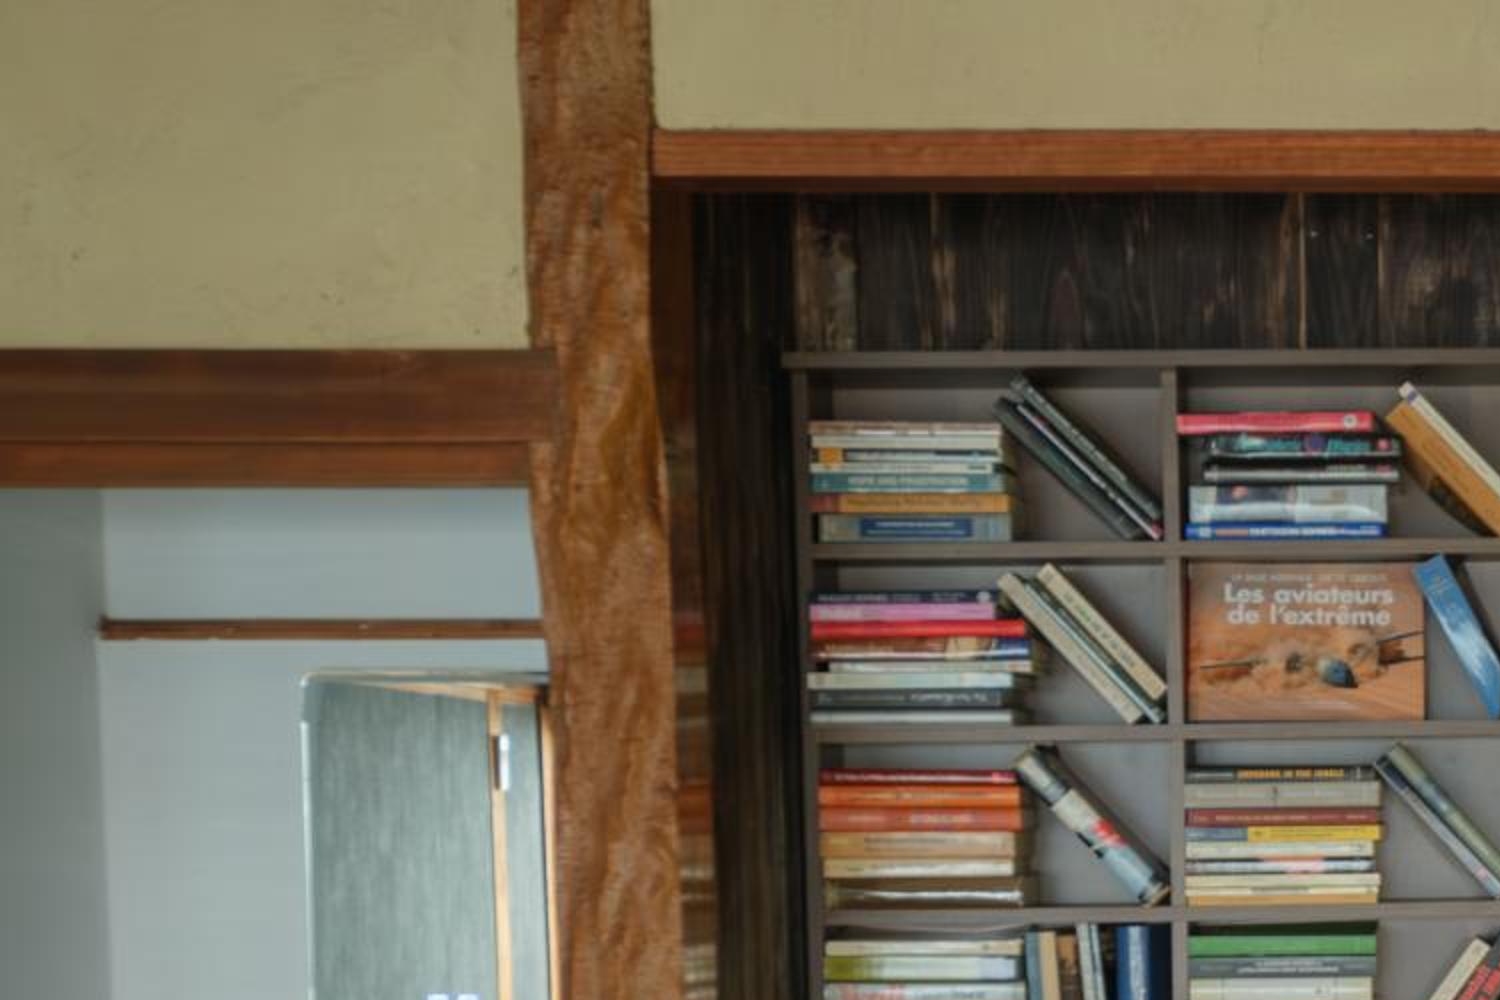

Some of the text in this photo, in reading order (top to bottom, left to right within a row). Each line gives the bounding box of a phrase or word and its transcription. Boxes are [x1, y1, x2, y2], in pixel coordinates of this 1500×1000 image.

[1224, 582, 1393, 604] Les aviateurs
[1227, 605, 1260, 625] de
